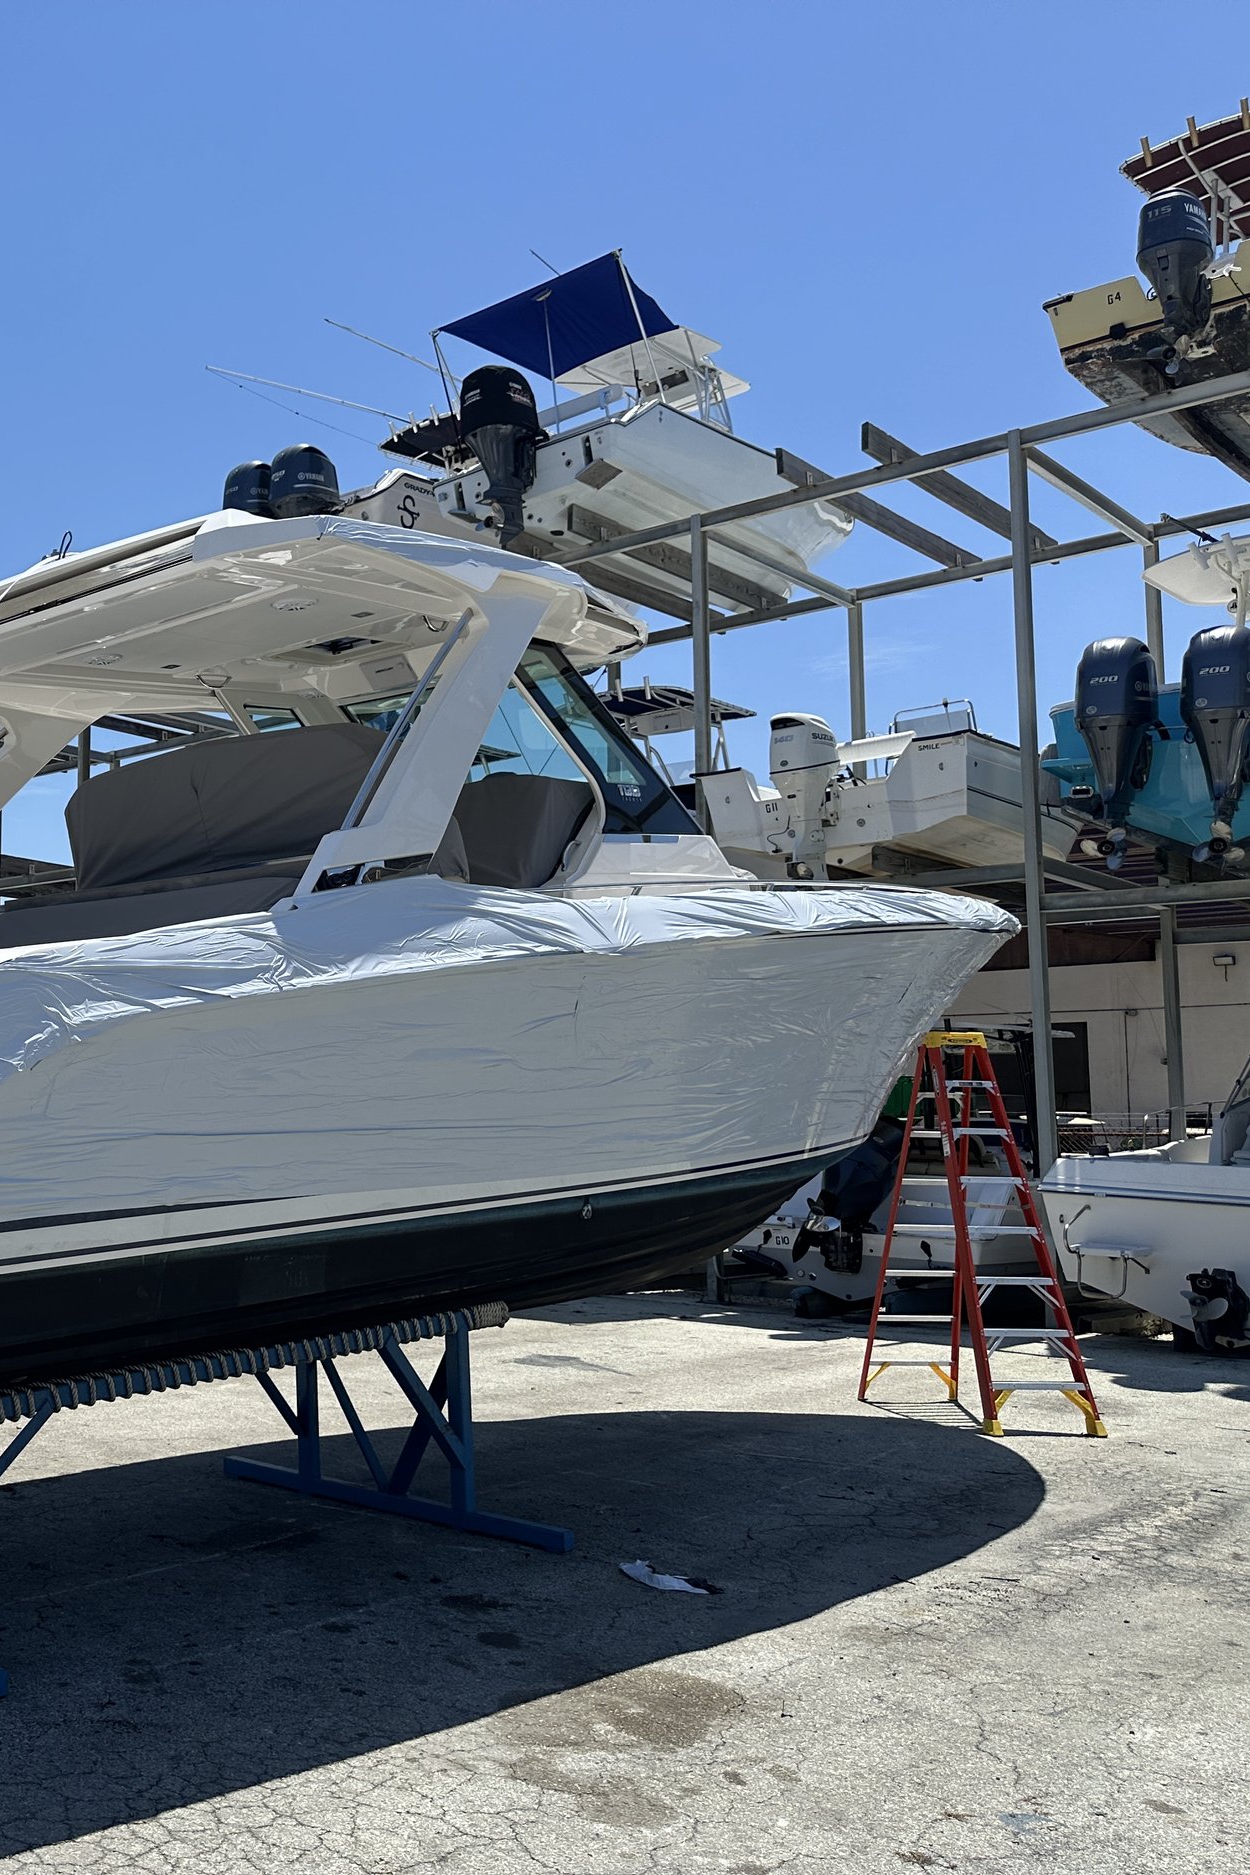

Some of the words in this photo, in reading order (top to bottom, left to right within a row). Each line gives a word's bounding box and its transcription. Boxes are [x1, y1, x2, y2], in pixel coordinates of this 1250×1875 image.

[1107, 291, 1121, 305] G4
[1199, 665, 1230, 675] 200
[1090, 675, 1119, 684] 200
[918, 743, 940, 751] SMILE
[775, 1235, 790, 1246] G10
